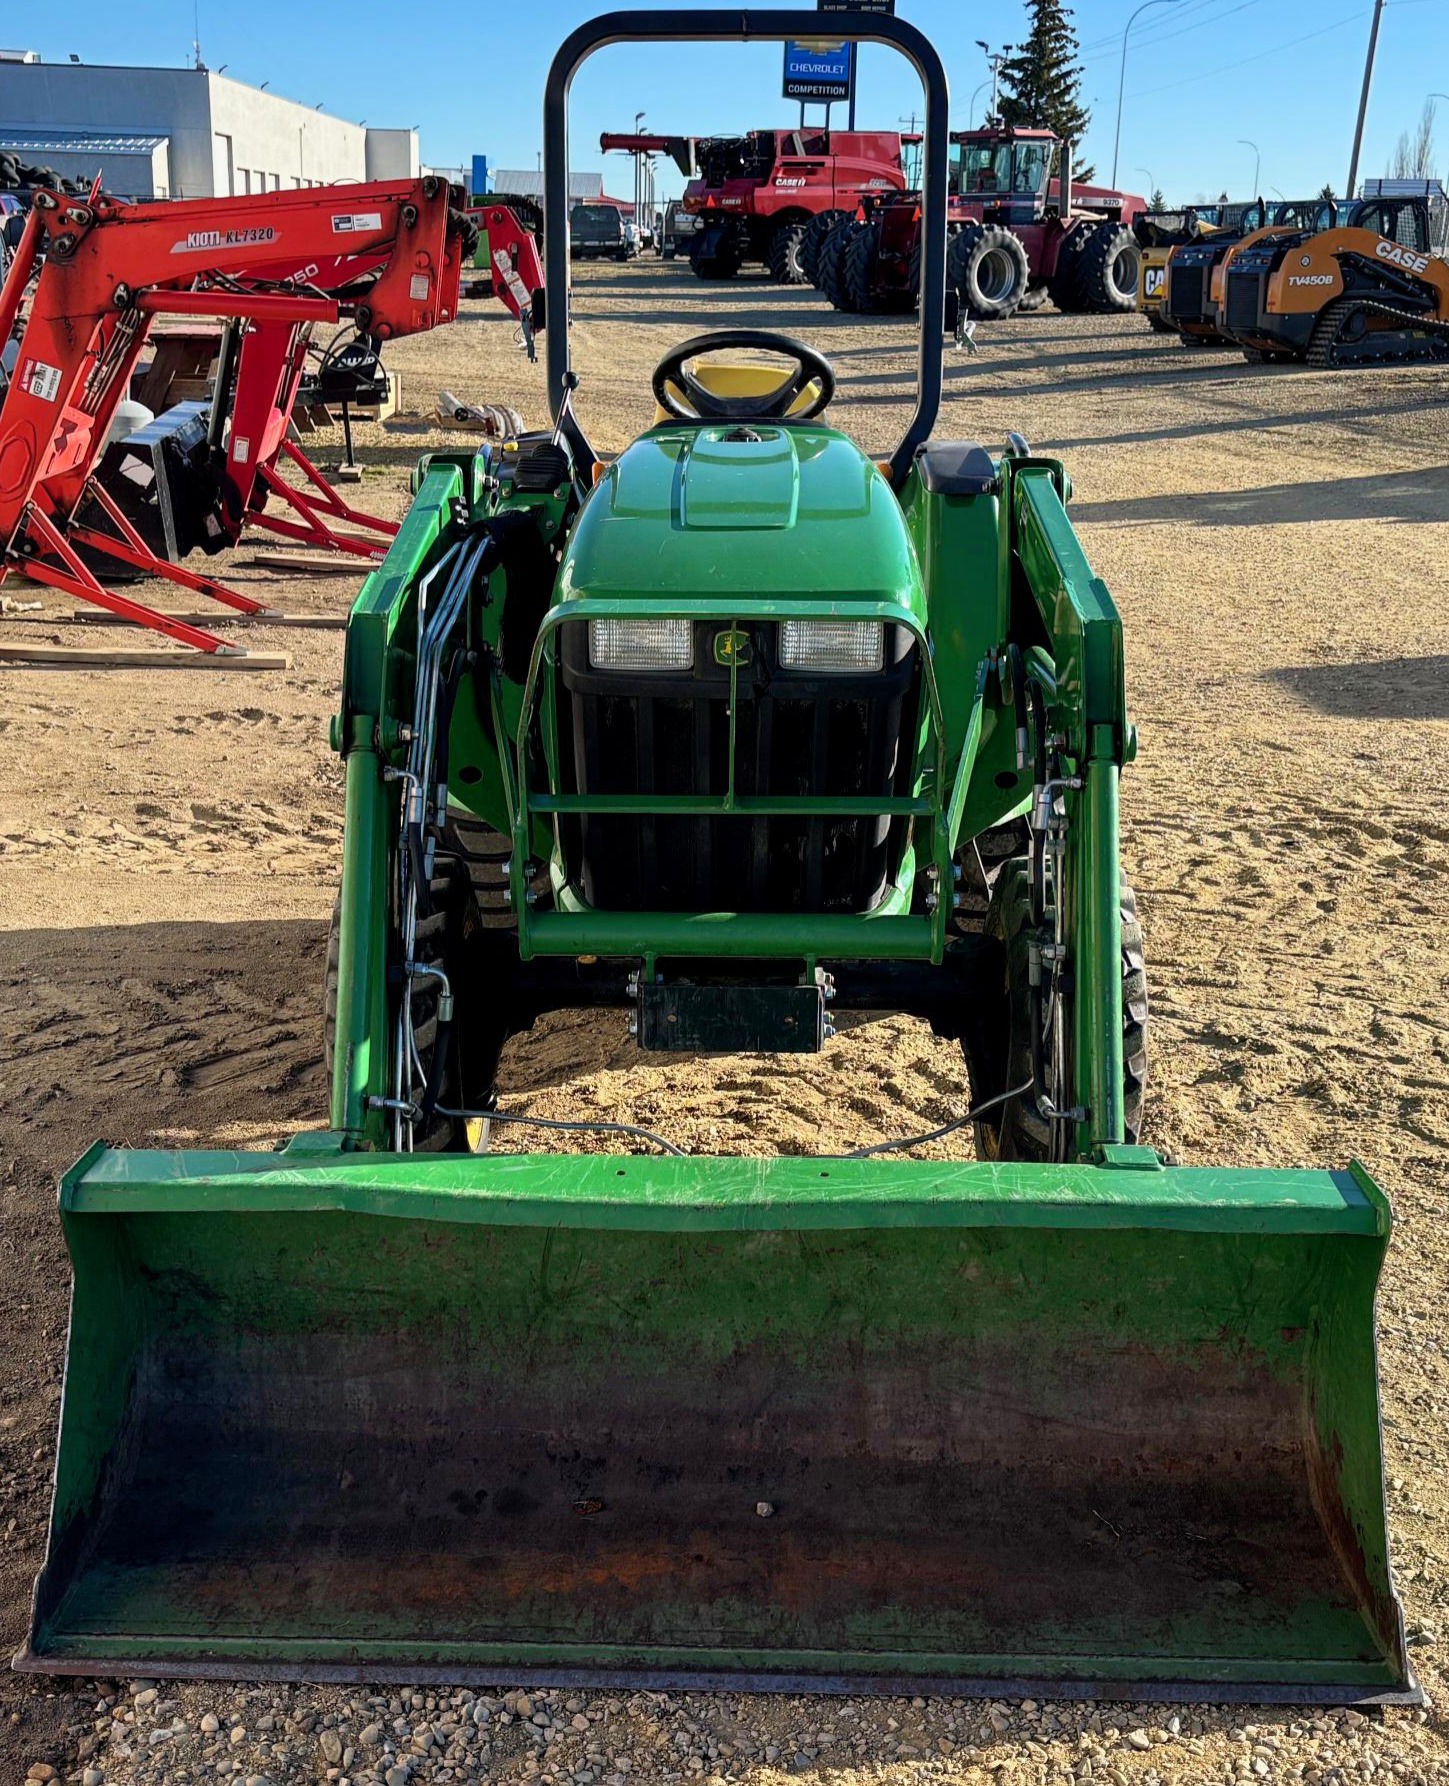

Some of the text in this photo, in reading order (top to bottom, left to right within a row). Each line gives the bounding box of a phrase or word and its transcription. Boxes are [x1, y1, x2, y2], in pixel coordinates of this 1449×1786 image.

[789, 62, 845, 74] CHEVROLET
[788, 84, 846, 95] COMPETITION
[1102, 198, 1120, 206] 9370
[187, 227, 274, 248] KIOTI KL7320
[1375, 241, 1430, 274] CASE
[1145, 269, 1164, 296] CA
[1288, 275, 1334, 287] TV450B
